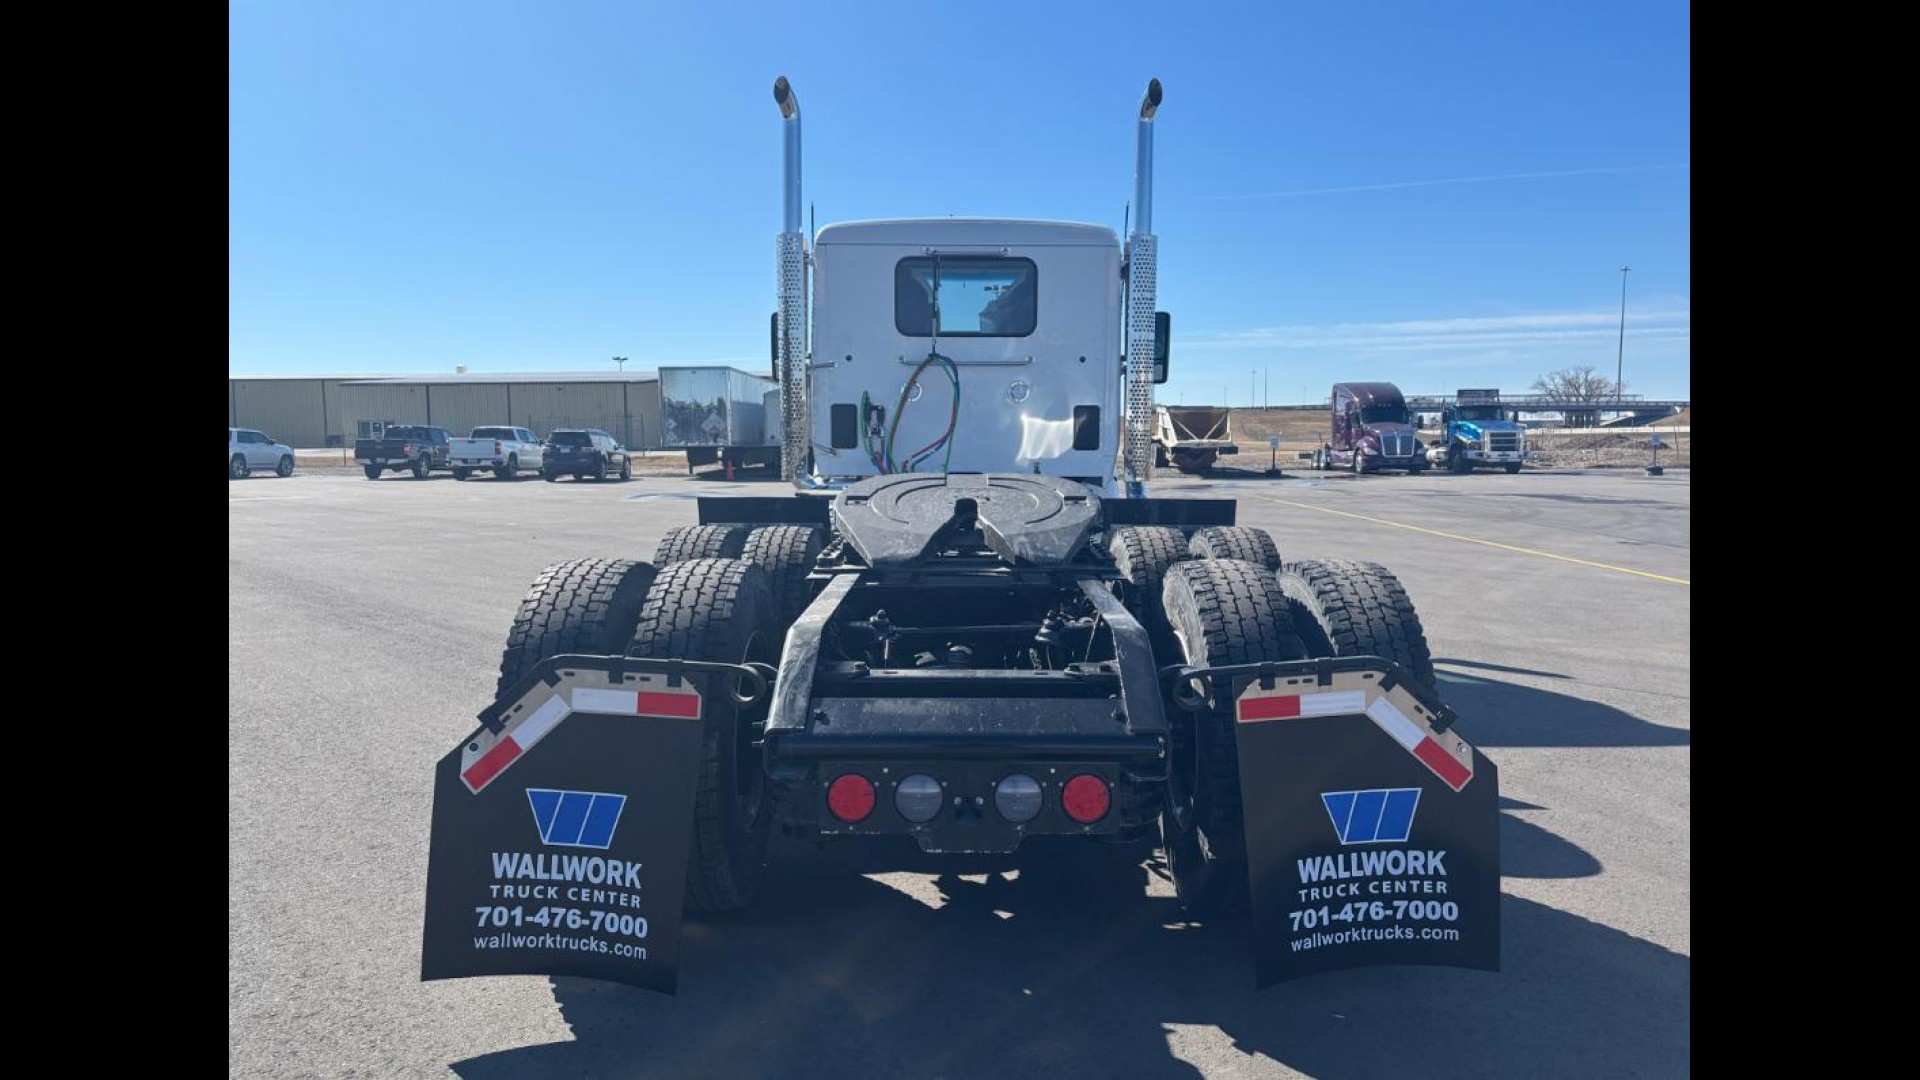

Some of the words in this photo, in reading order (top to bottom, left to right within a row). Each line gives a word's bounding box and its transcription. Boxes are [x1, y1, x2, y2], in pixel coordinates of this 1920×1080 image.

[491, 852, 643, 889] WALLWORK
[1297, 849, 1447, 884] WALLWORK
[489, 884, 559, 900] TRUCK
[567, 887, 641, 909] CENTER
[1298, 882, 1360, 903] TRUCK
[1368, 880, 1448, 895] CENTER
[475, 906, 648, 939] 701-476-7000
[1288, 900, 1459, 932] 701-476-7000
[474, 933, 647, 960] wallworktrucks.com
[1291, 924, 1459, 952] wallworktrucks.com
